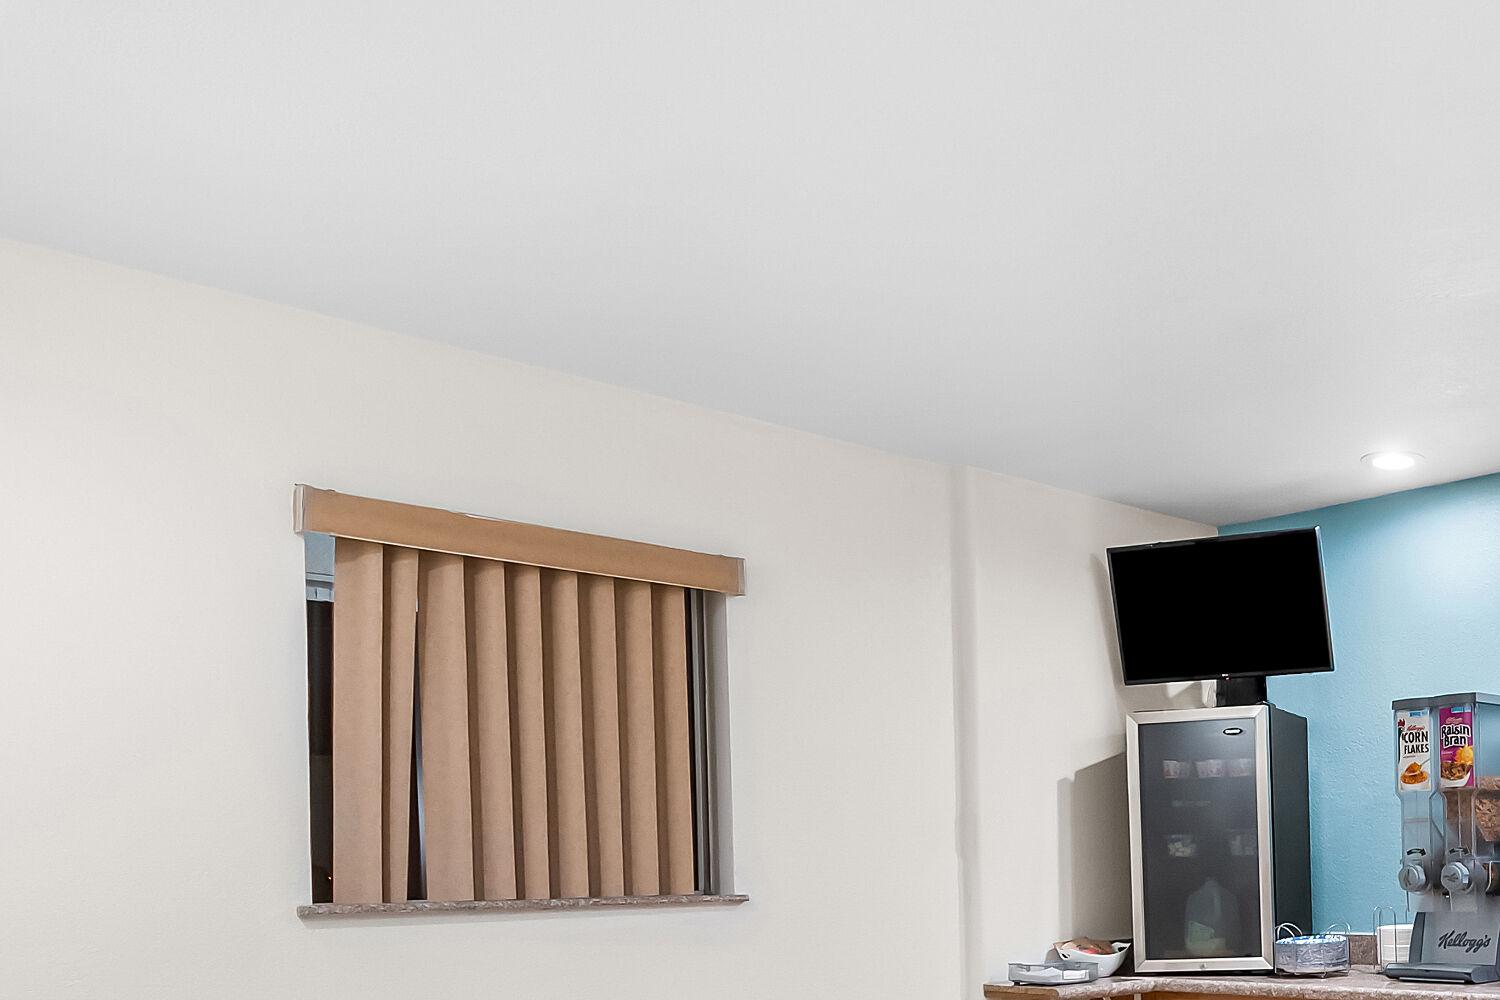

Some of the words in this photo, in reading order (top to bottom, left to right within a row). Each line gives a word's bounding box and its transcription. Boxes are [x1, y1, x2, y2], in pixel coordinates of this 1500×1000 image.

[1404, 731, 1429, 743] CORN
[1441, 724, 1470, 738] Raisin
[1443, 736, 1467, 748] Bran
[1404, 744, 1429, 755] FLAKES
[1438, 929, 1491, 953] Kellogg's
